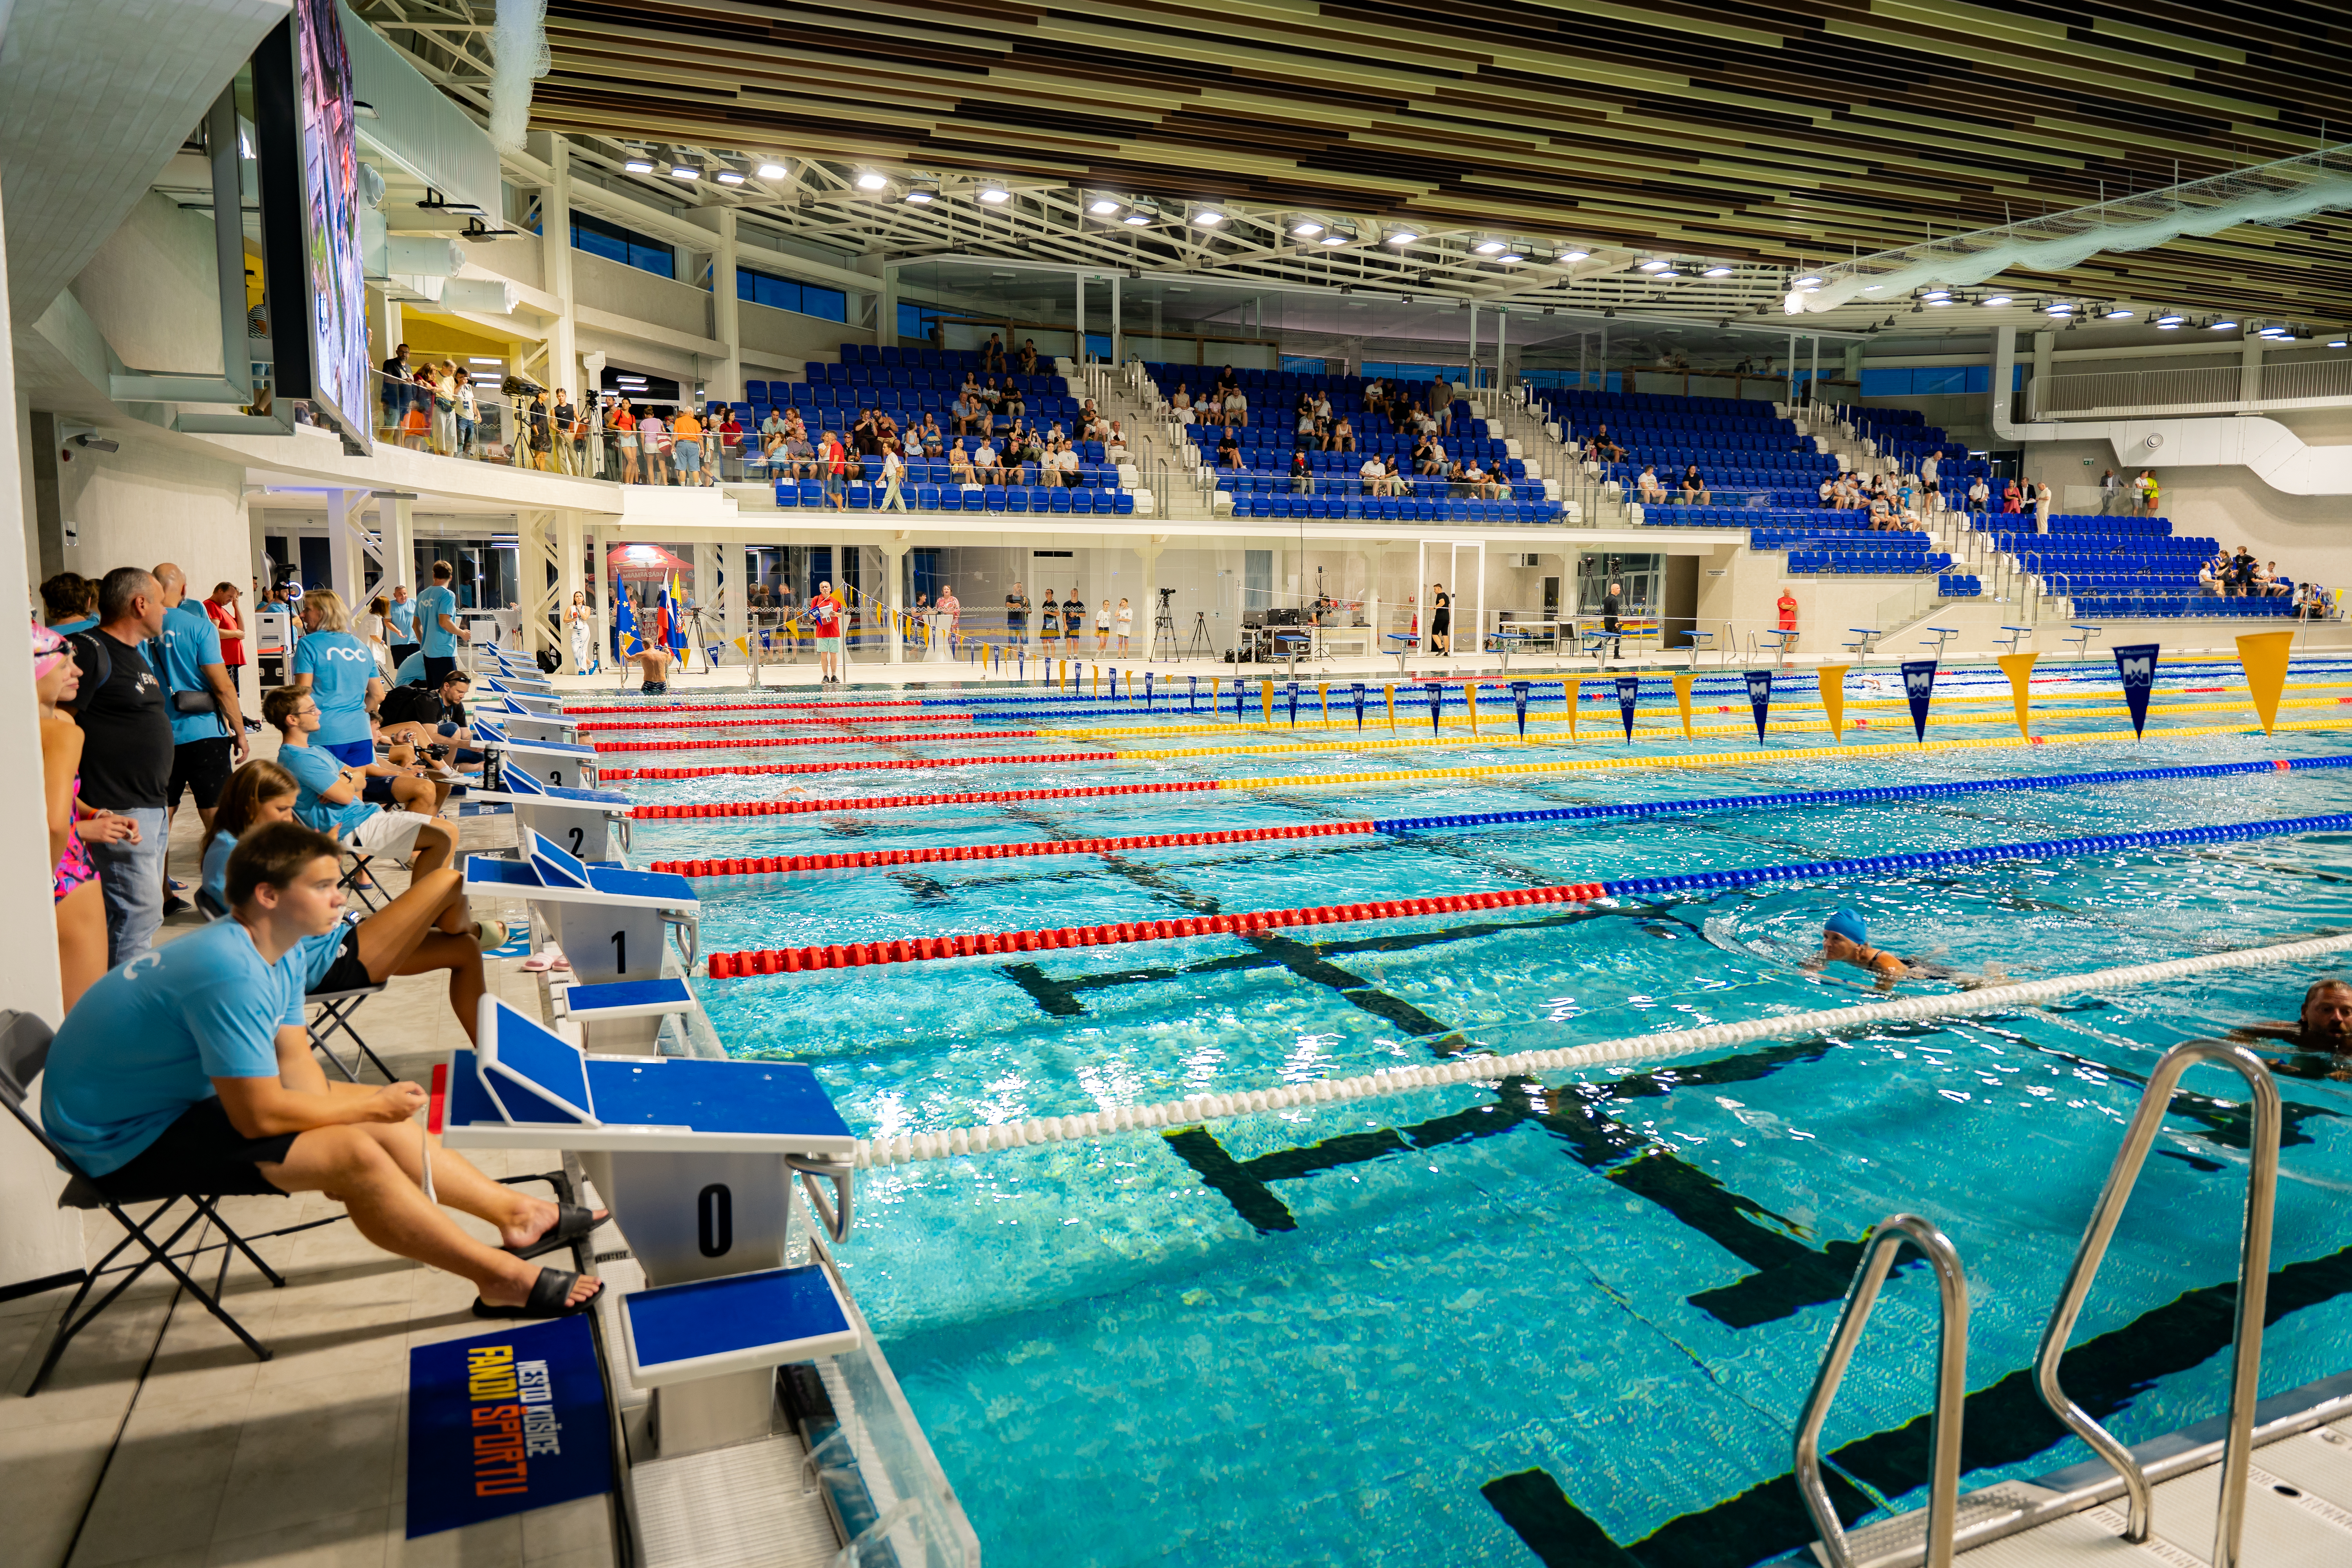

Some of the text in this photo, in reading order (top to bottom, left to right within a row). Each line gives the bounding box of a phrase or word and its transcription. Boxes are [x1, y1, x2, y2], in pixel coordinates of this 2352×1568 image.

[550, 771, 562, 786] 3
[569, 828, 584, 858] 2
[611, 930, 626, 974] 1
[698, 1183, 733, 1258] 0
[467, 1345, 528, 1497] FANDÍ ŠPORTU
[516, 1359, 562, 1457] MESTO KOŠICE
